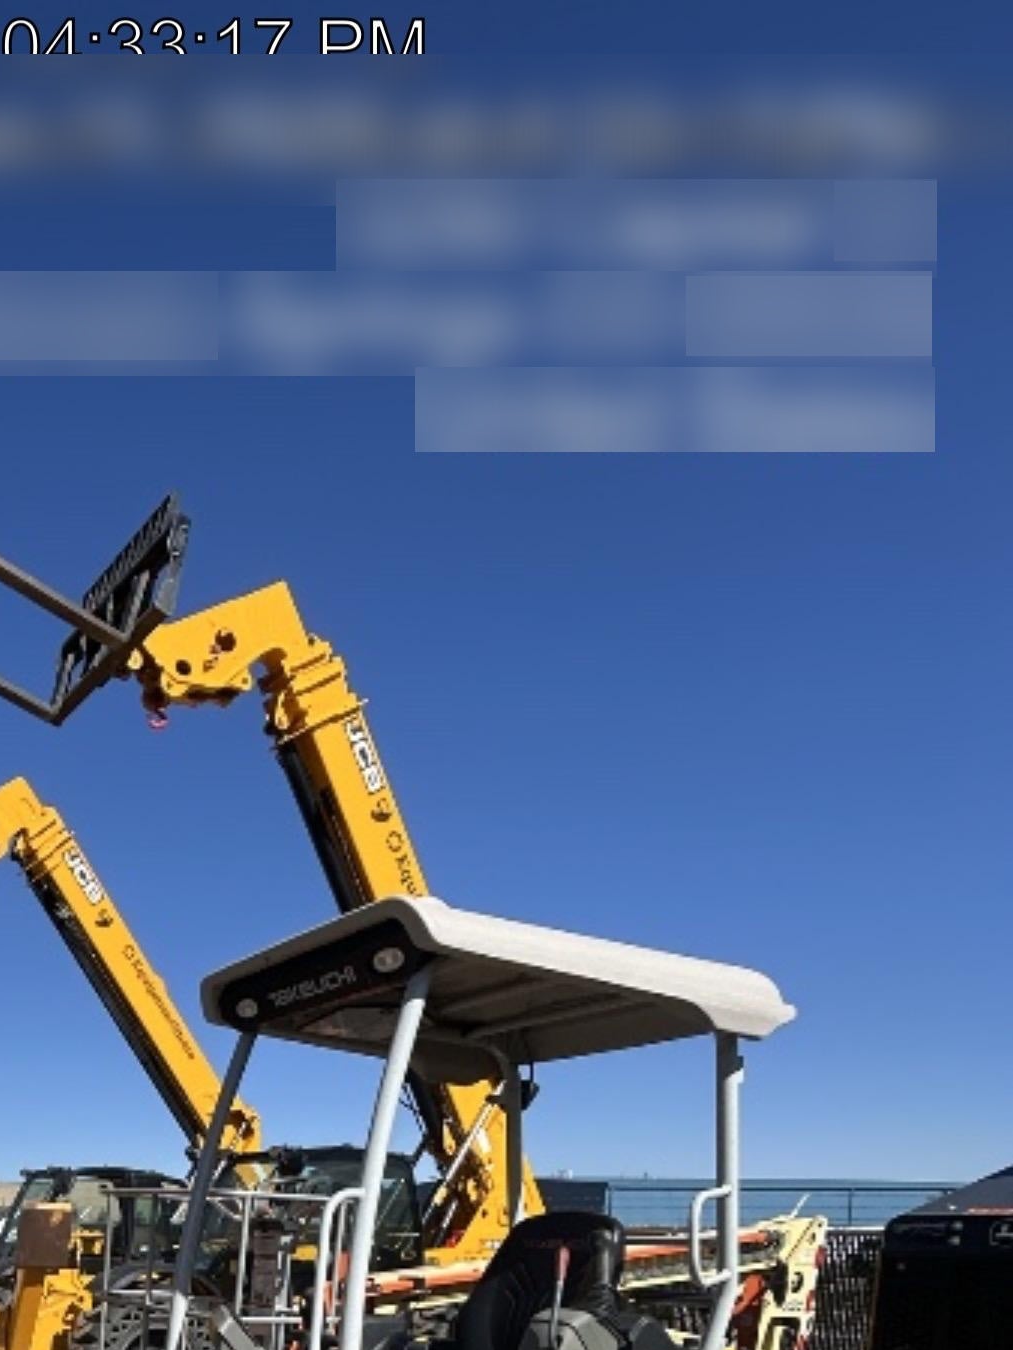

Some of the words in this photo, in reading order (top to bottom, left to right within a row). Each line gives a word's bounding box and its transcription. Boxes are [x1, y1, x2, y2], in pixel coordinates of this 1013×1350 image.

[344, 713, 385, 794] JCB
[65, 849, 104, 904] JCB
[267, 965, 357, 1007] TAKEUCHI
